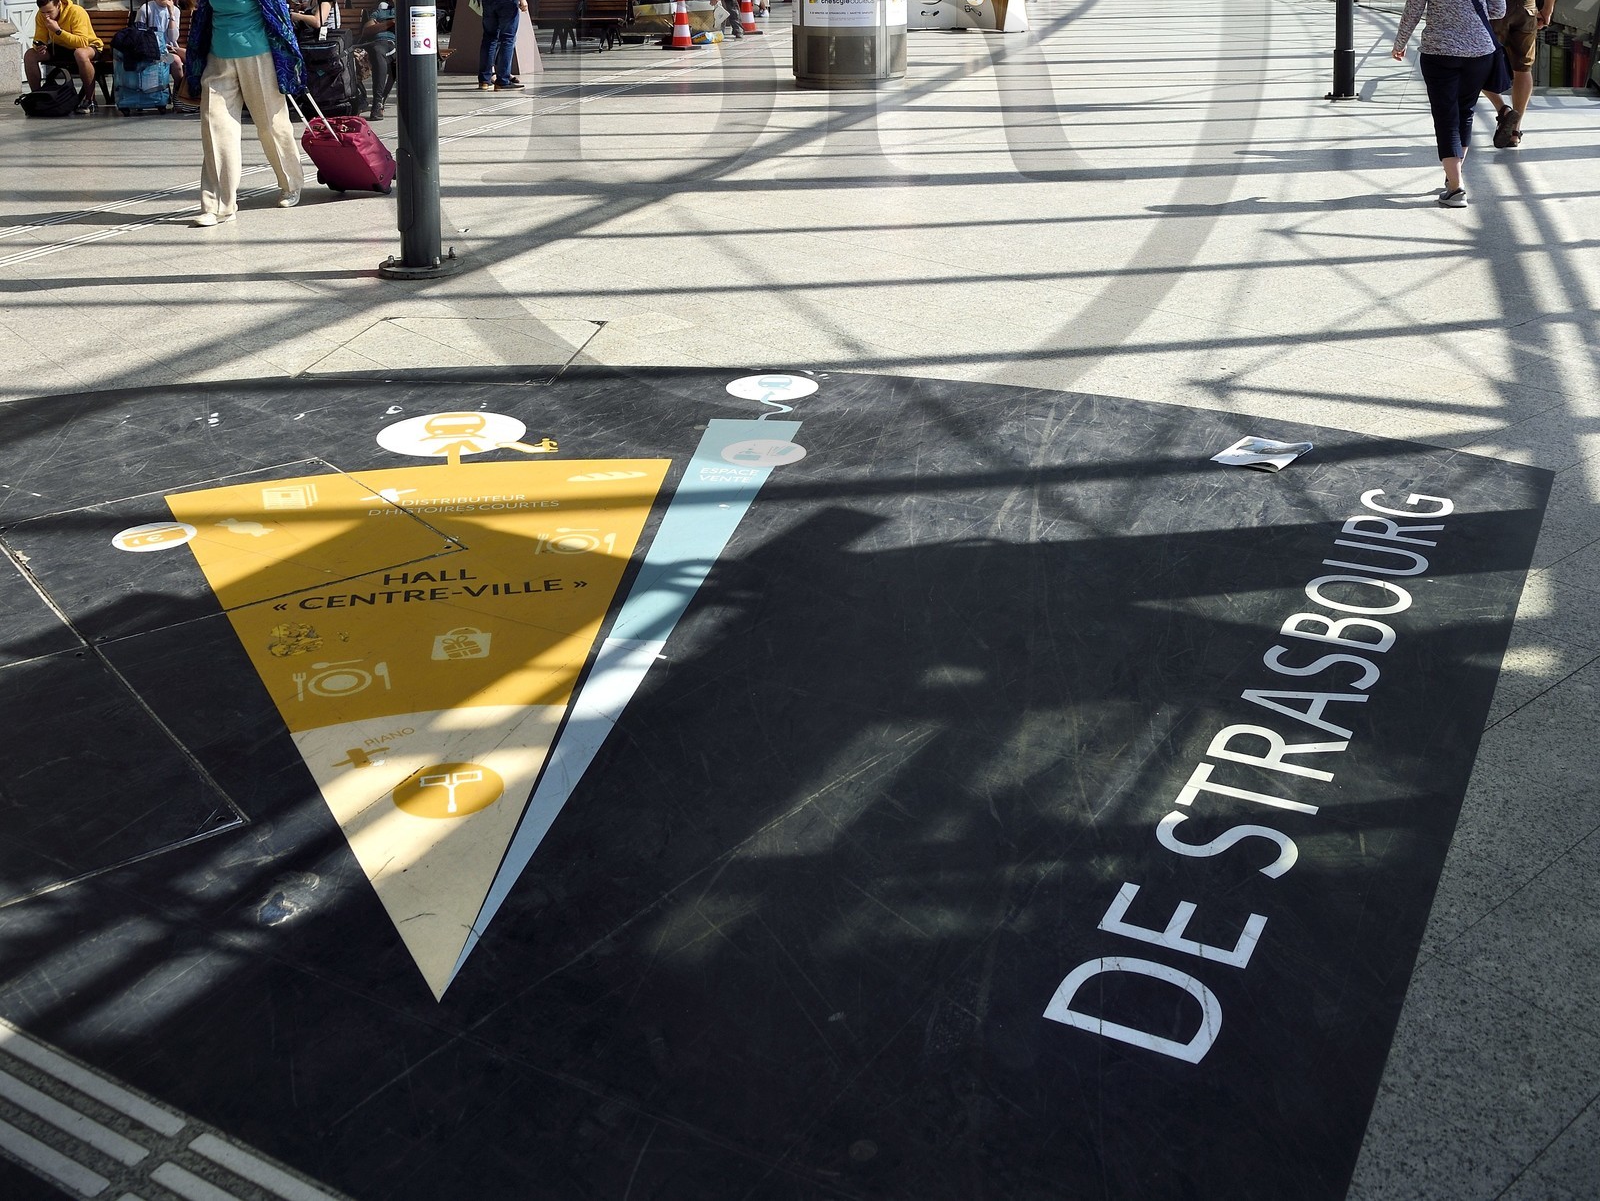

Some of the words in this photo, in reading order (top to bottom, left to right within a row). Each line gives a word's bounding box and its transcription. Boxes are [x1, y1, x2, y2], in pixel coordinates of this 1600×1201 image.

[700, 468, 760, 476] ESPACE
[700, 474, 754, 484] VENTE
[368, 504, 475, 517] D'HISTOIRES
[478, 500, 560, 510] COURTES
[401, 494, 526, 506] DISTRIBUTEUR
[384, 568, 477, 586] HALL
[298, 578, 564, 610] CENTRE-VILLE
[364, 727, 415, 746] PIANO
[1042, 880, 1268, 1066] DE
[1155, 488, 1454, 880] STRASBOURG
